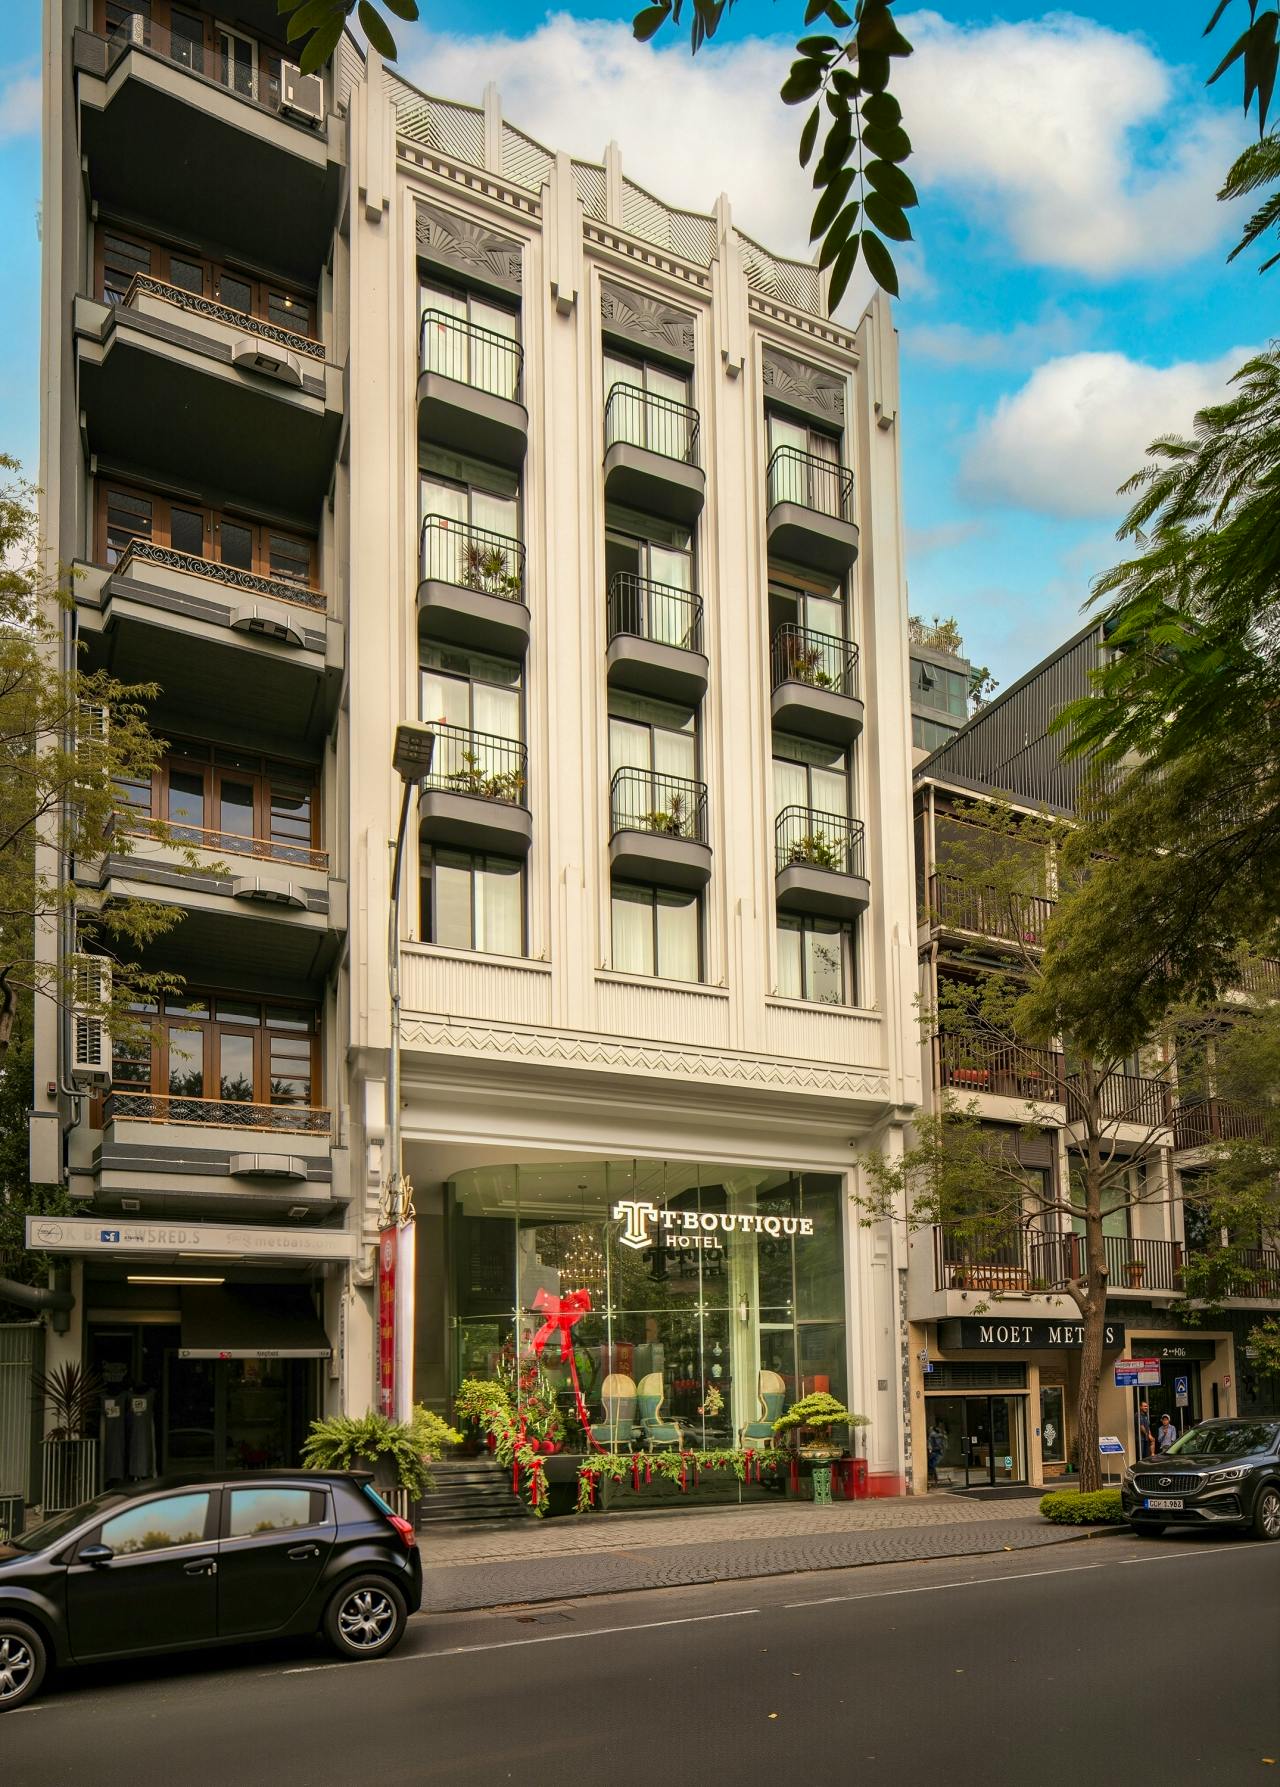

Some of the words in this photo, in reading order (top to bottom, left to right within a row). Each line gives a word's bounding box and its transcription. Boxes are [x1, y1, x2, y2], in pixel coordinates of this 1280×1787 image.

[666, 1235, 723, 1249] HOTEL
[979, 1326, 1033, 1343] MOET
[1048, 1326, 1115, 1343] METS
